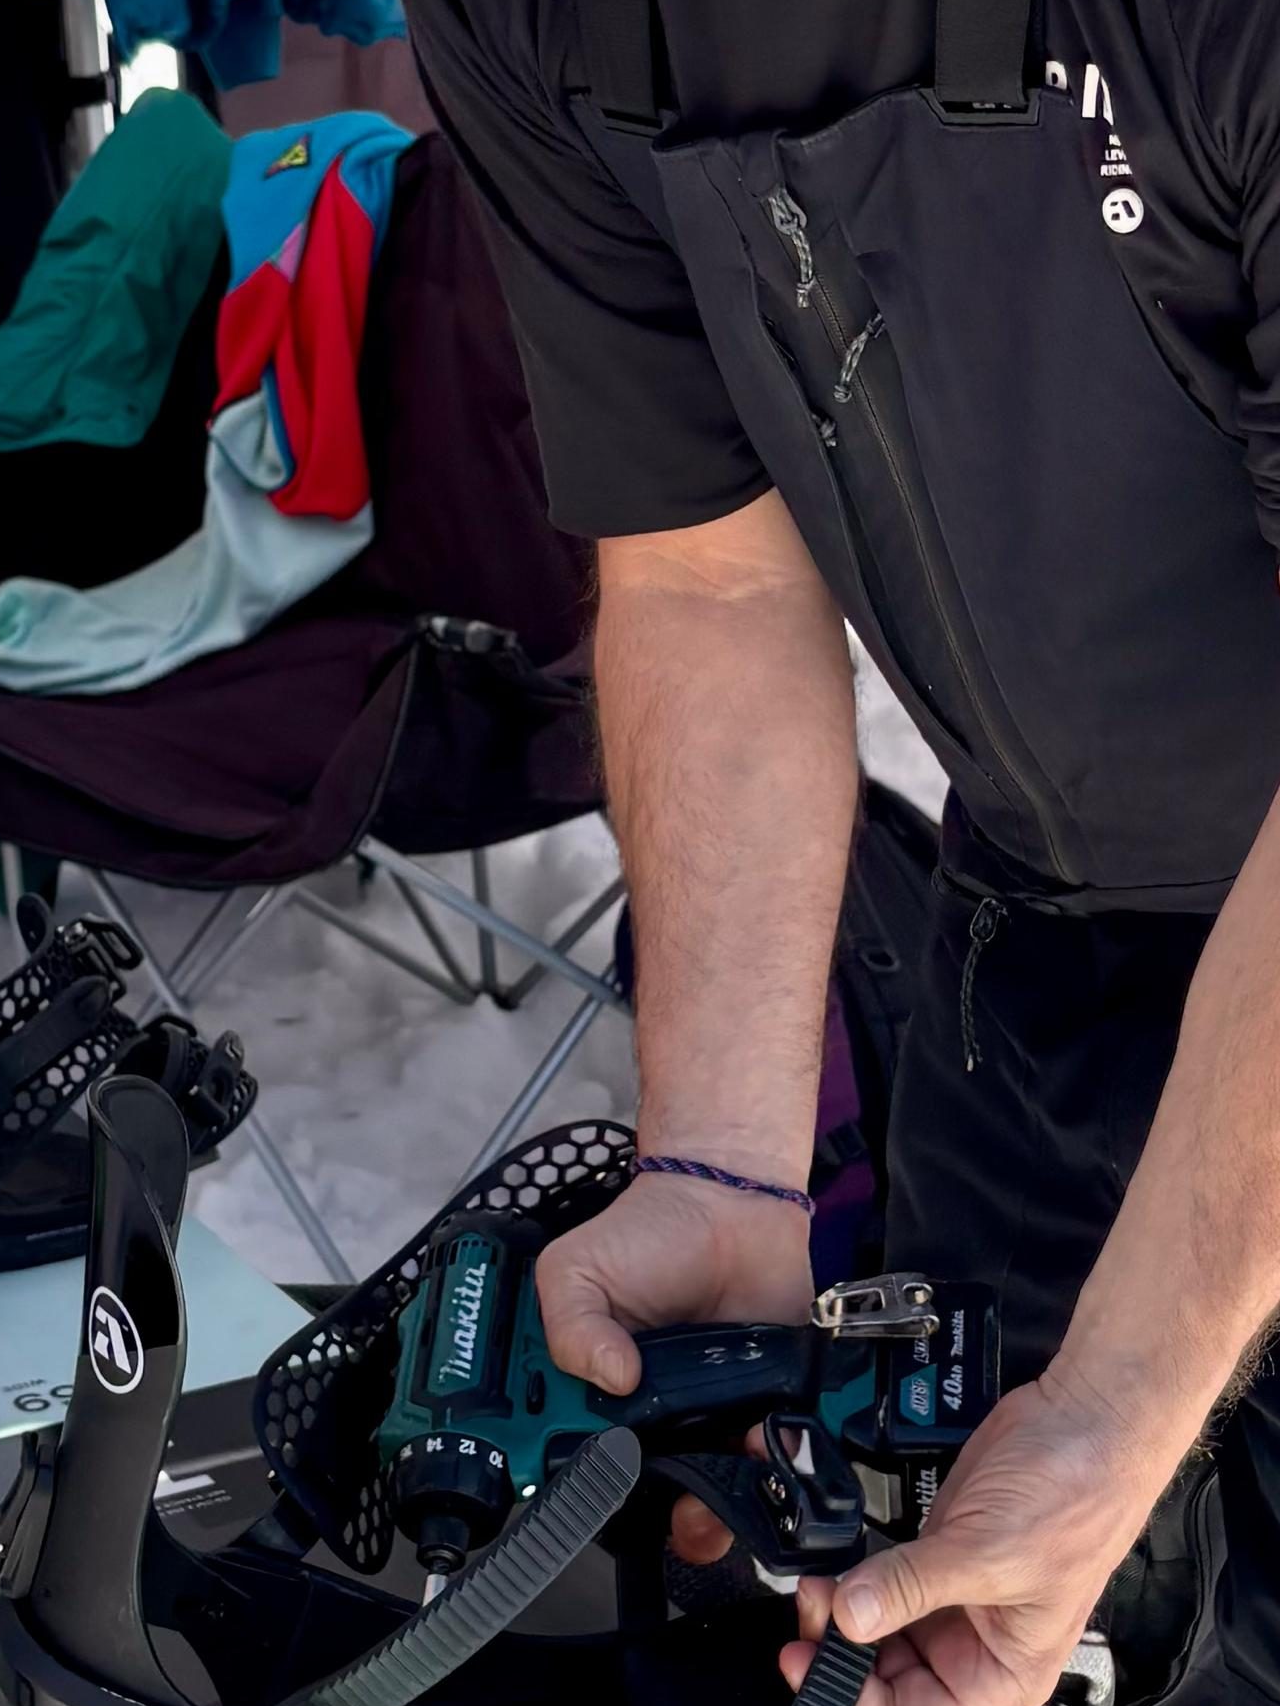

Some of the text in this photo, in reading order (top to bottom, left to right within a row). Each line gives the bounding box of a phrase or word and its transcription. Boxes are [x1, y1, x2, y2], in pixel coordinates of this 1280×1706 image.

[425, 1437, 445, 1454] 14
[458, 1438, 478, 1456] 12
[488, 1450, 505, 1469] 10
